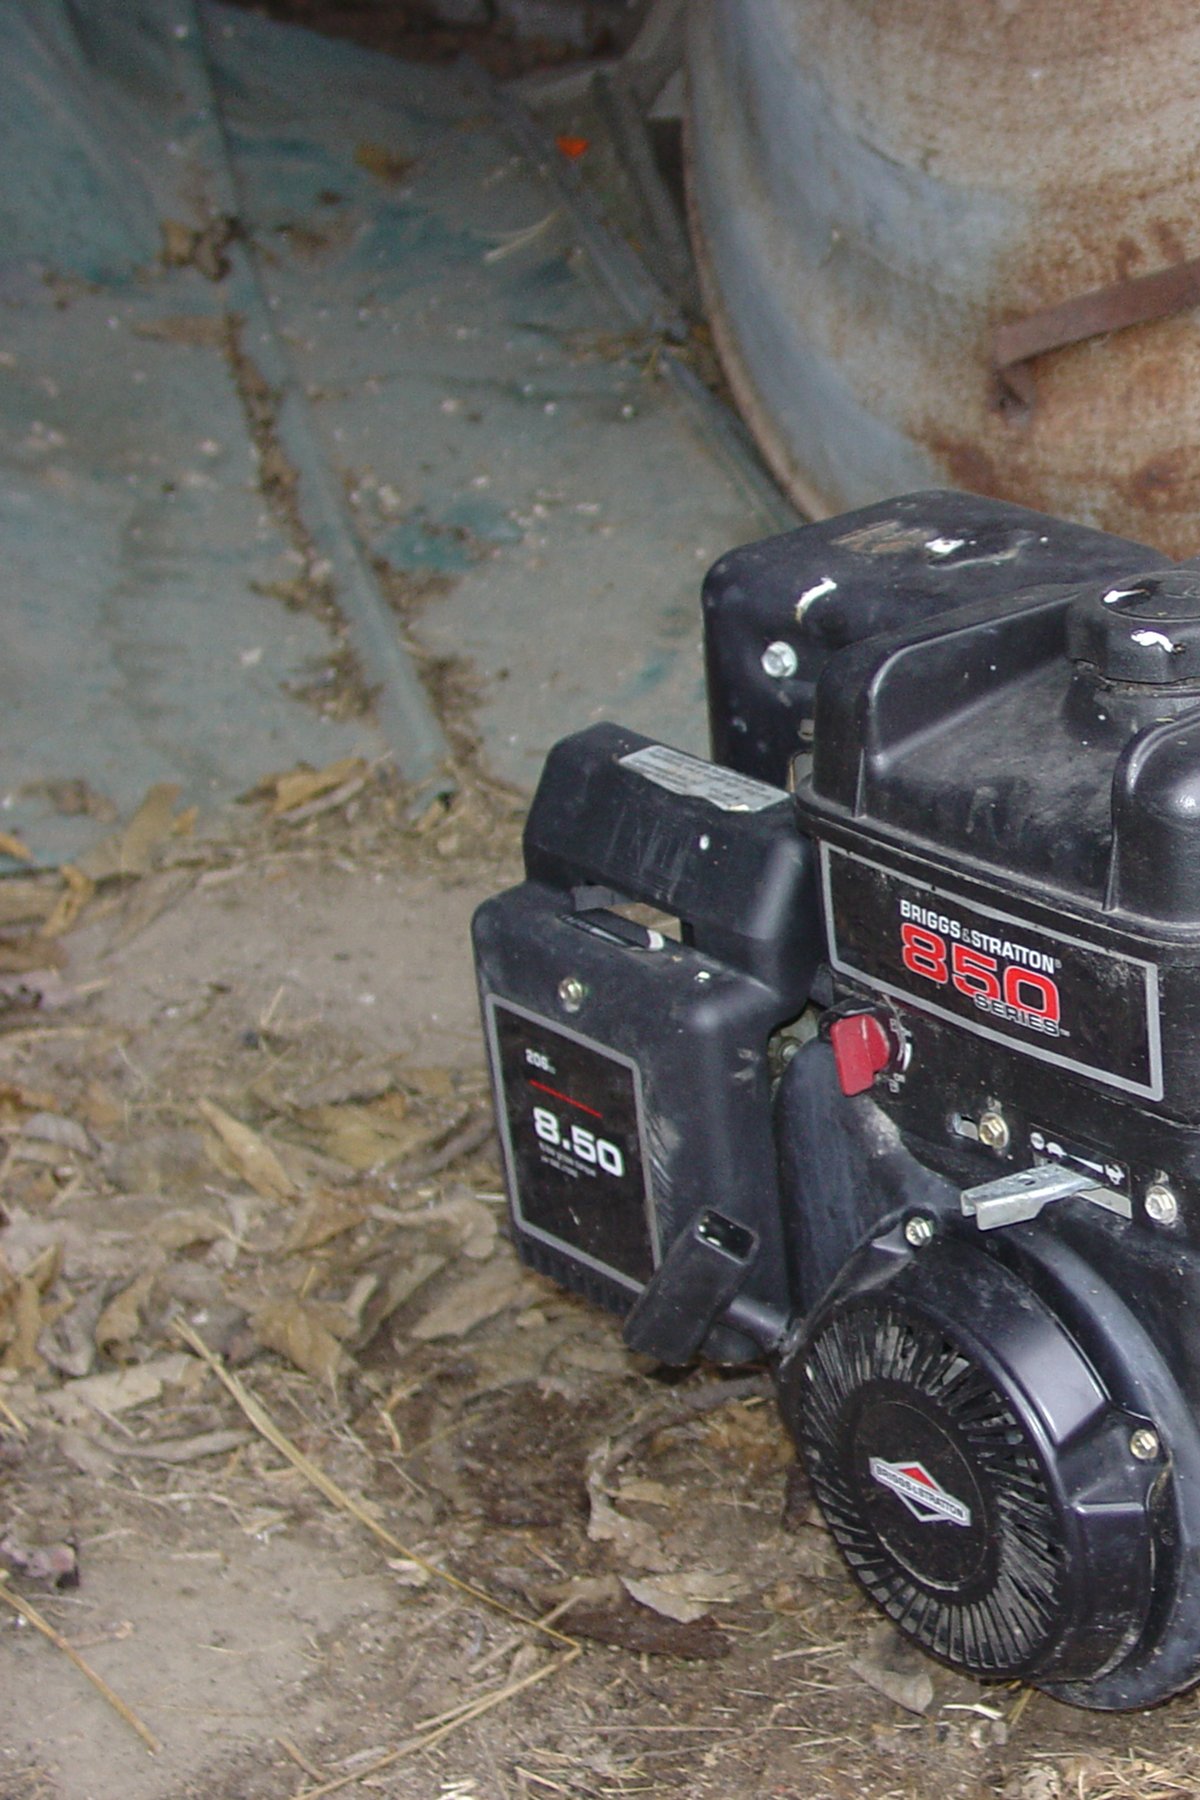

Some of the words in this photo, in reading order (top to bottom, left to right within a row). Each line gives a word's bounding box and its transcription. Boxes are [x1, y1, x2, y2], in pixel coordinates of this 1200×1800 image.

[901, 922, 1060, 1022] 850
[973, 992, 1060, 1037] SERIES
[533, 1106, 624, 1177] 8.50
